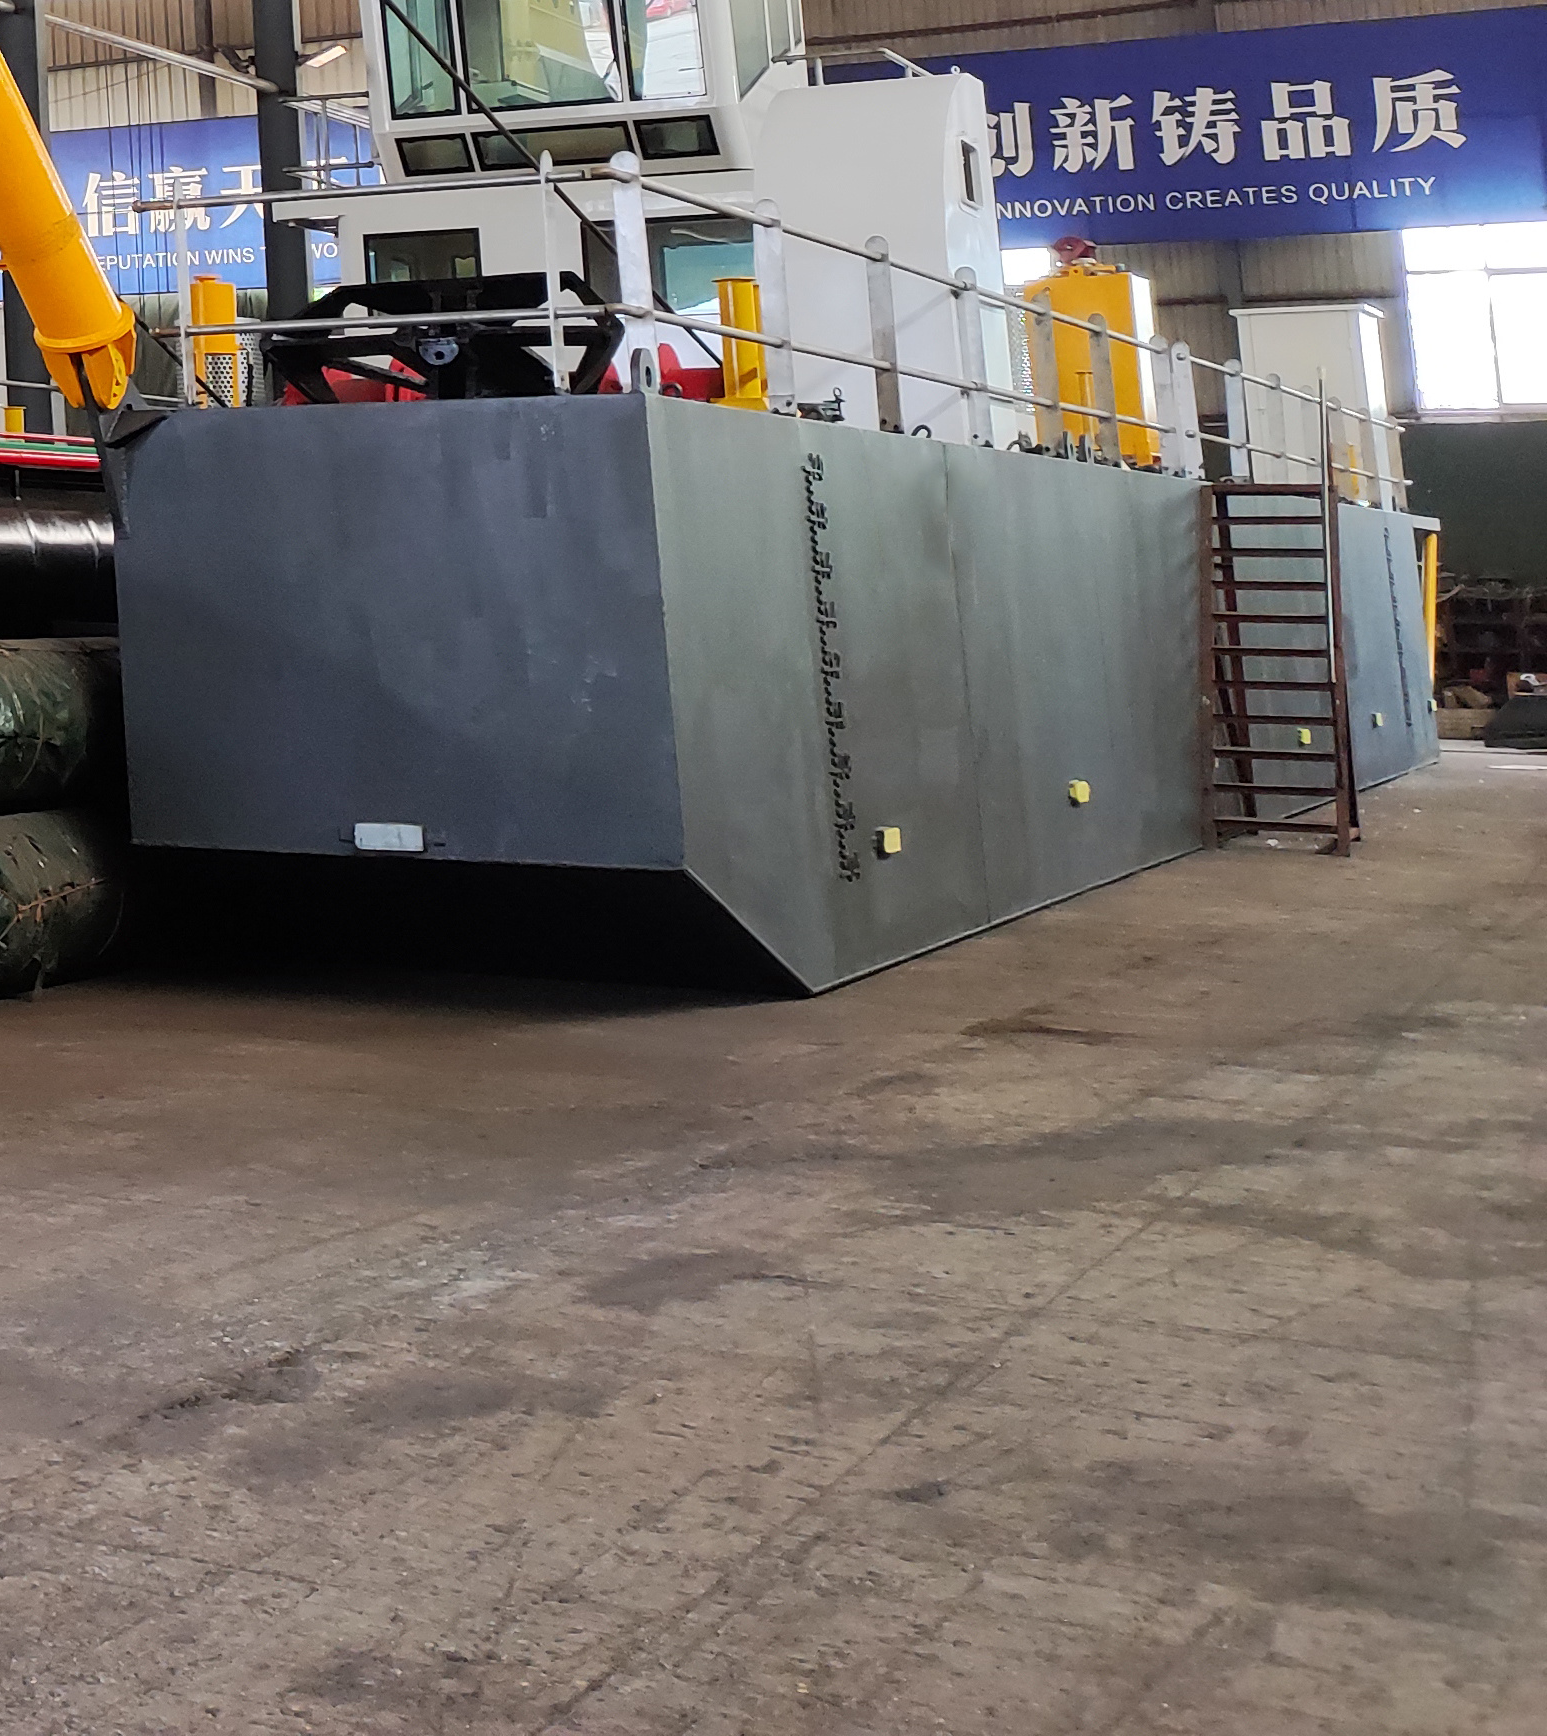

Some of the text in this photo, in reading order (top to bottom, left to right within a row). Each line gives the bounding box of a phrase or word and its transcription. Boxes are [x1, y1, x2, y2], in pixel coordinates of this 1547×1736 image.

[995, 175, 1437, 220] NNOVATION CREATES QUALITY
[204, 247, 255, 266] WINS
